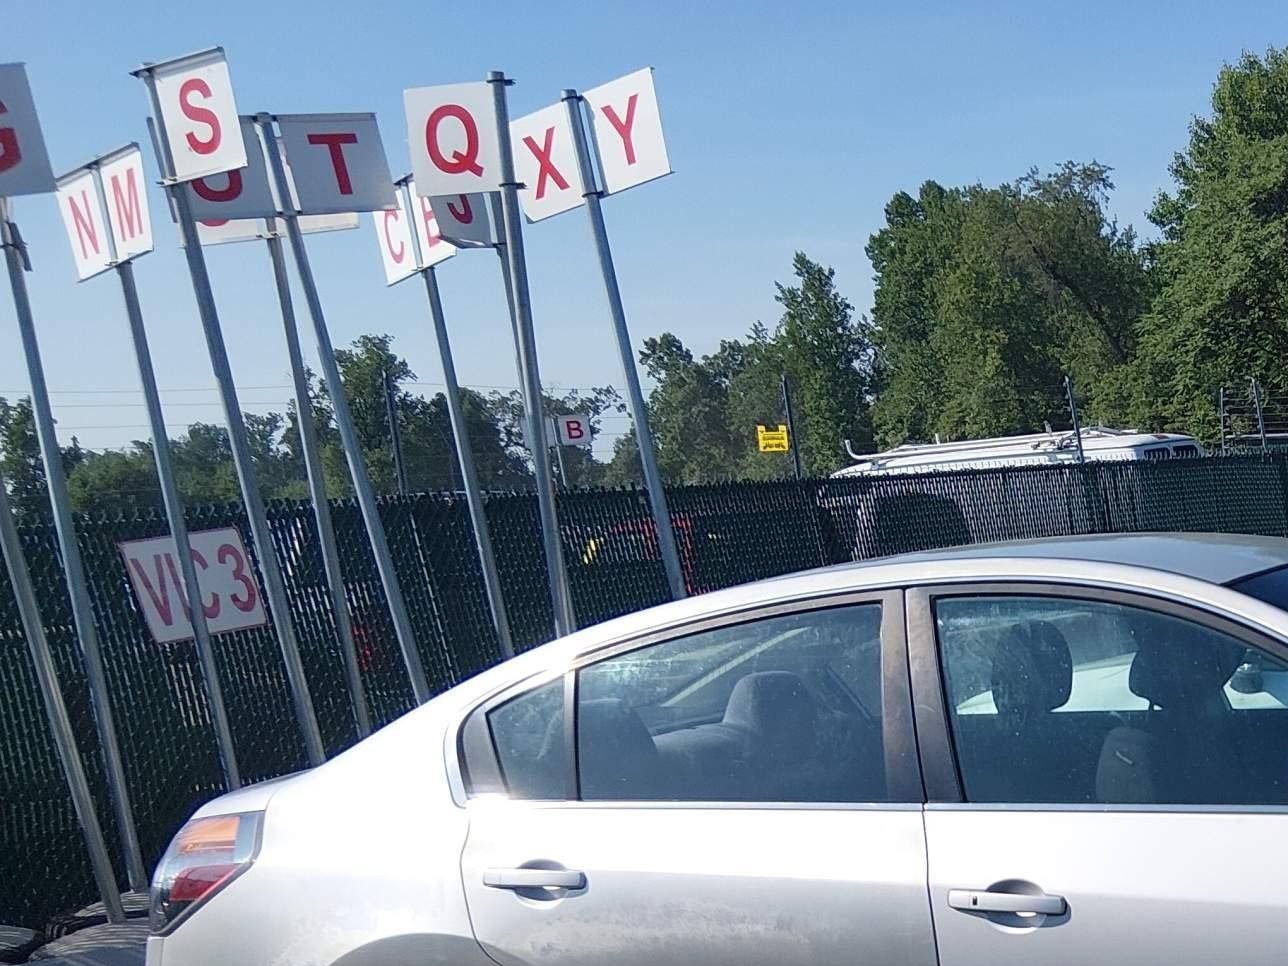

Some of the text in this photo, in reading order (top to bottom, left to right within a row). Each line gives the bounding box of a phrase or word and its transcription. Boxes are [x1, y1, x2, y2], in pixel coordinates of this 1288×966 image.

[179, 78, 222, 155] S
[425, 104, 484, 178] Q
[600, 94, 639, 166] Y
[307, 133, 358, 195] T
[522, 126, 570, 200] X
[69, 190, 100, 260] N
[111, 168, 143, 242] M
[384, 209, 405, 264] C
[565, 420, 584, 440] B
